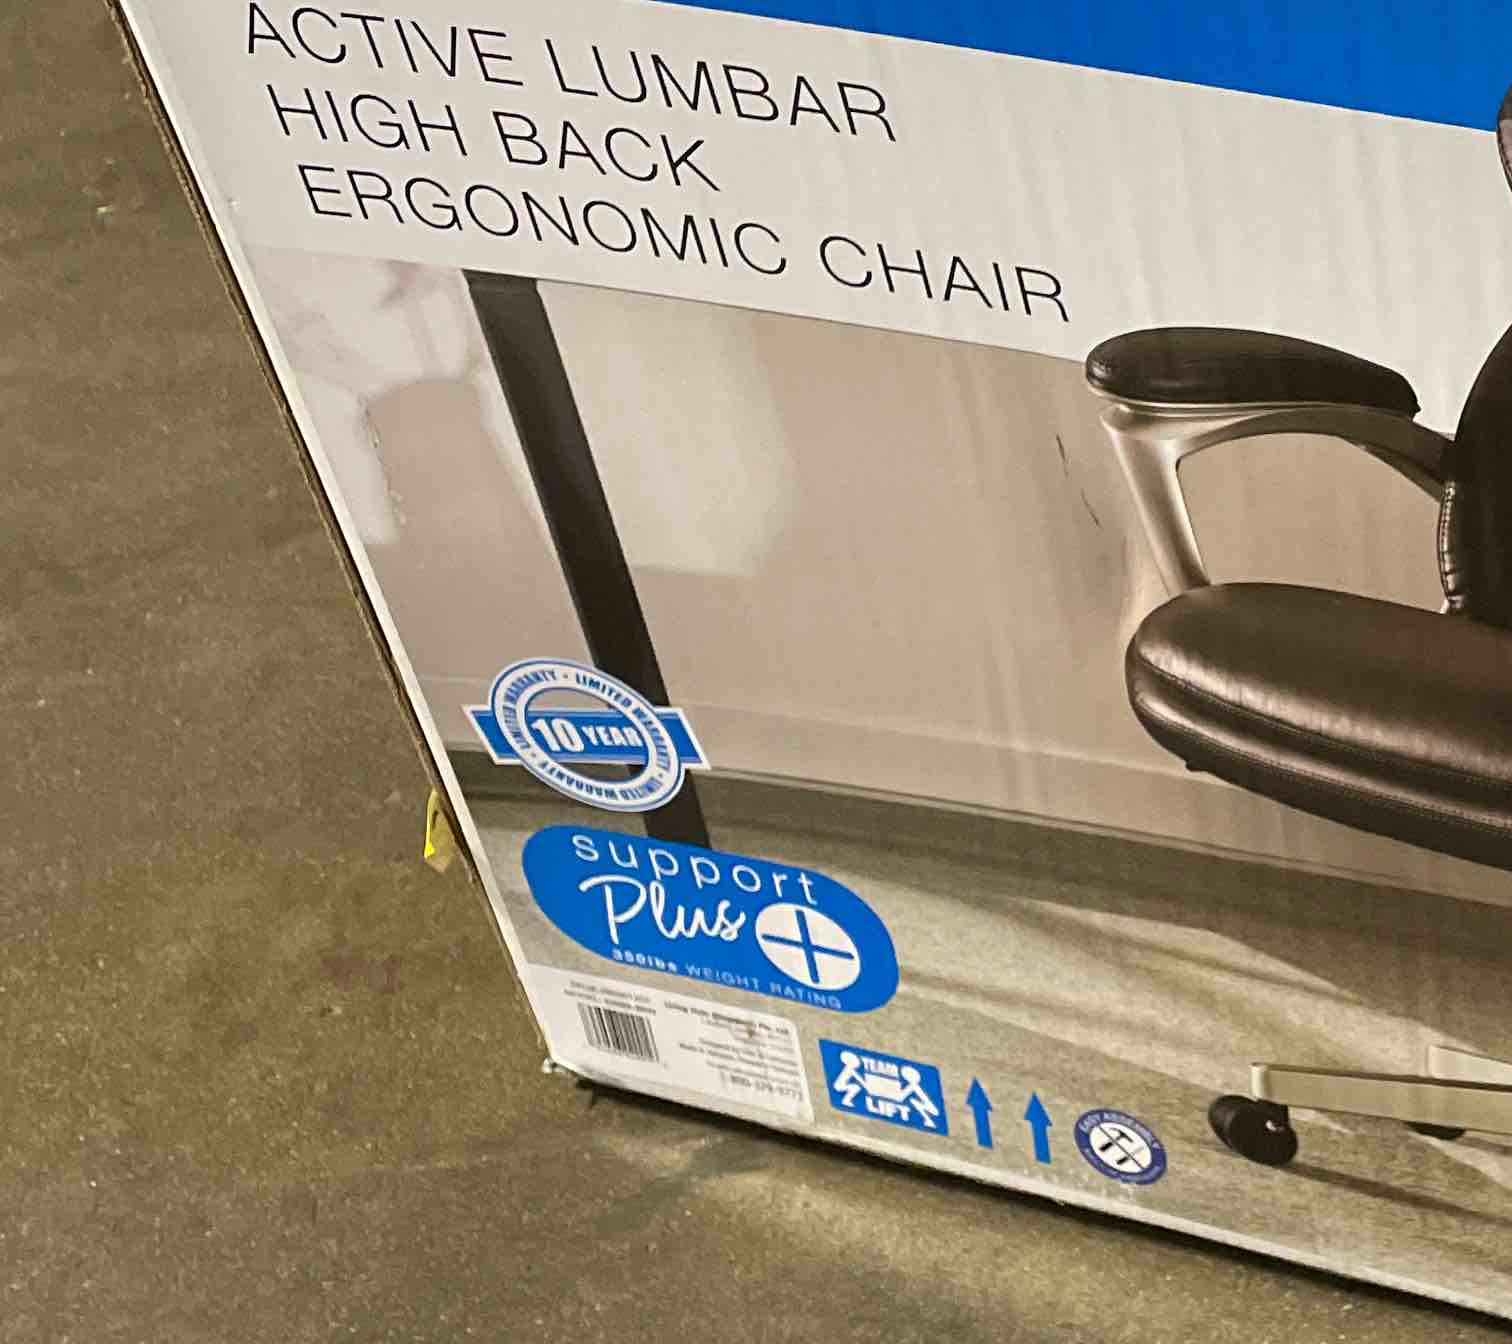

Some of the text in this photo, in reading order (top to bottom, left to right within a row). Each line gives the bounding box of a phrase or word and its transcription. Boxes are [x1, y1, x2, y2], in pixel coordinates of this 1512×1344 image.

[247, 1, 897, 142] ACTIVE LUMBAR
[266, 83, 721, 192] HIGH BACK
[297, 163, 1070, 323] ERGONOMIC CHAIR
[532, 717, 645, 753] 10 YEAR
[571, 834, 819, 906] support
[578, 873, 747, 945] Plus
[769, 982, 843, 1010] RATING
[862, 1056, 901, 1077] TEAM
[864, 1095, 913, 1121] LIFT
